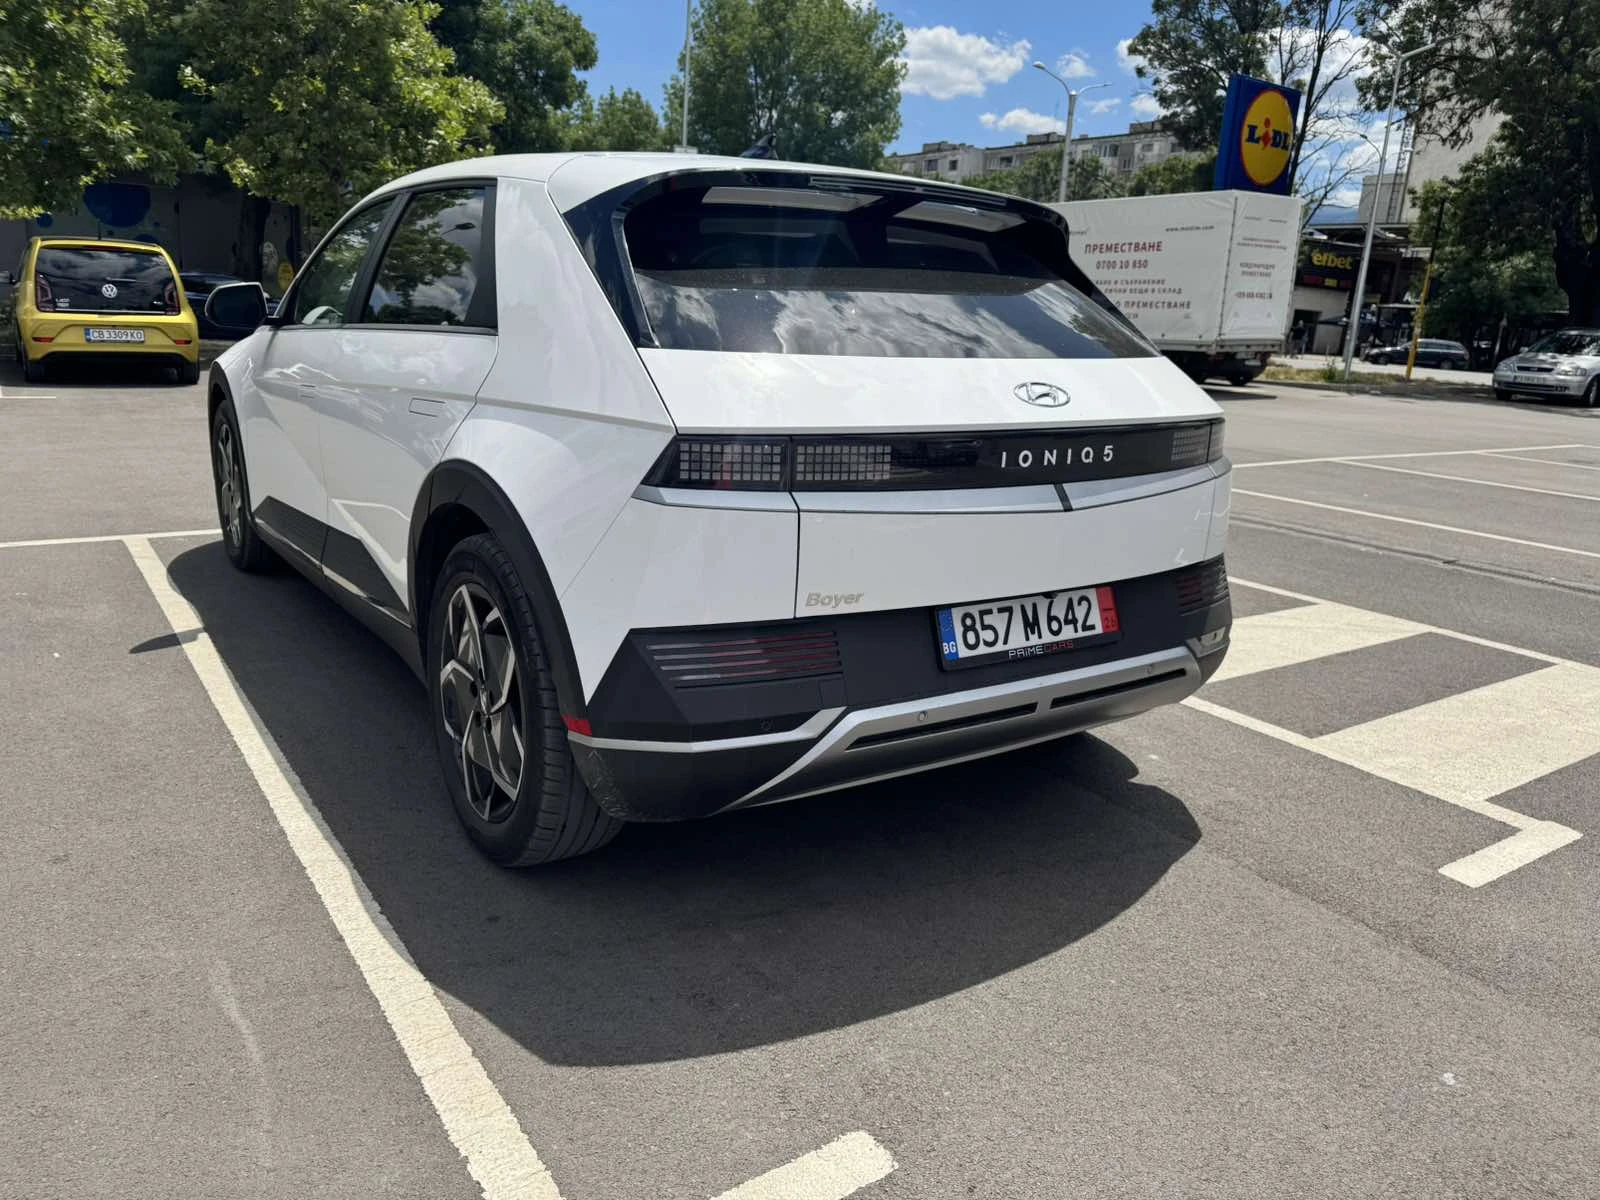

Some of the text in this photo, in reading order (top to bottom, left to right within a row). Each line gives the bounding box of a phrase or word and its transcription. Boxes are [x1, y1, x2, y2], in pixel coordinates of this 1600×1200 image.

[1084, 240, 1164, 254] ПРЕМЕСТВАНЕ
[1095, 260, 1117, 270] 0700
[1119, 260, 1130, 270] 10
[1124, 300, 1191, 310] ПРЕМЕСТВАНЕ
[806, 592, 864, 608] Boyer
[943, 641, 956, 654] BG
